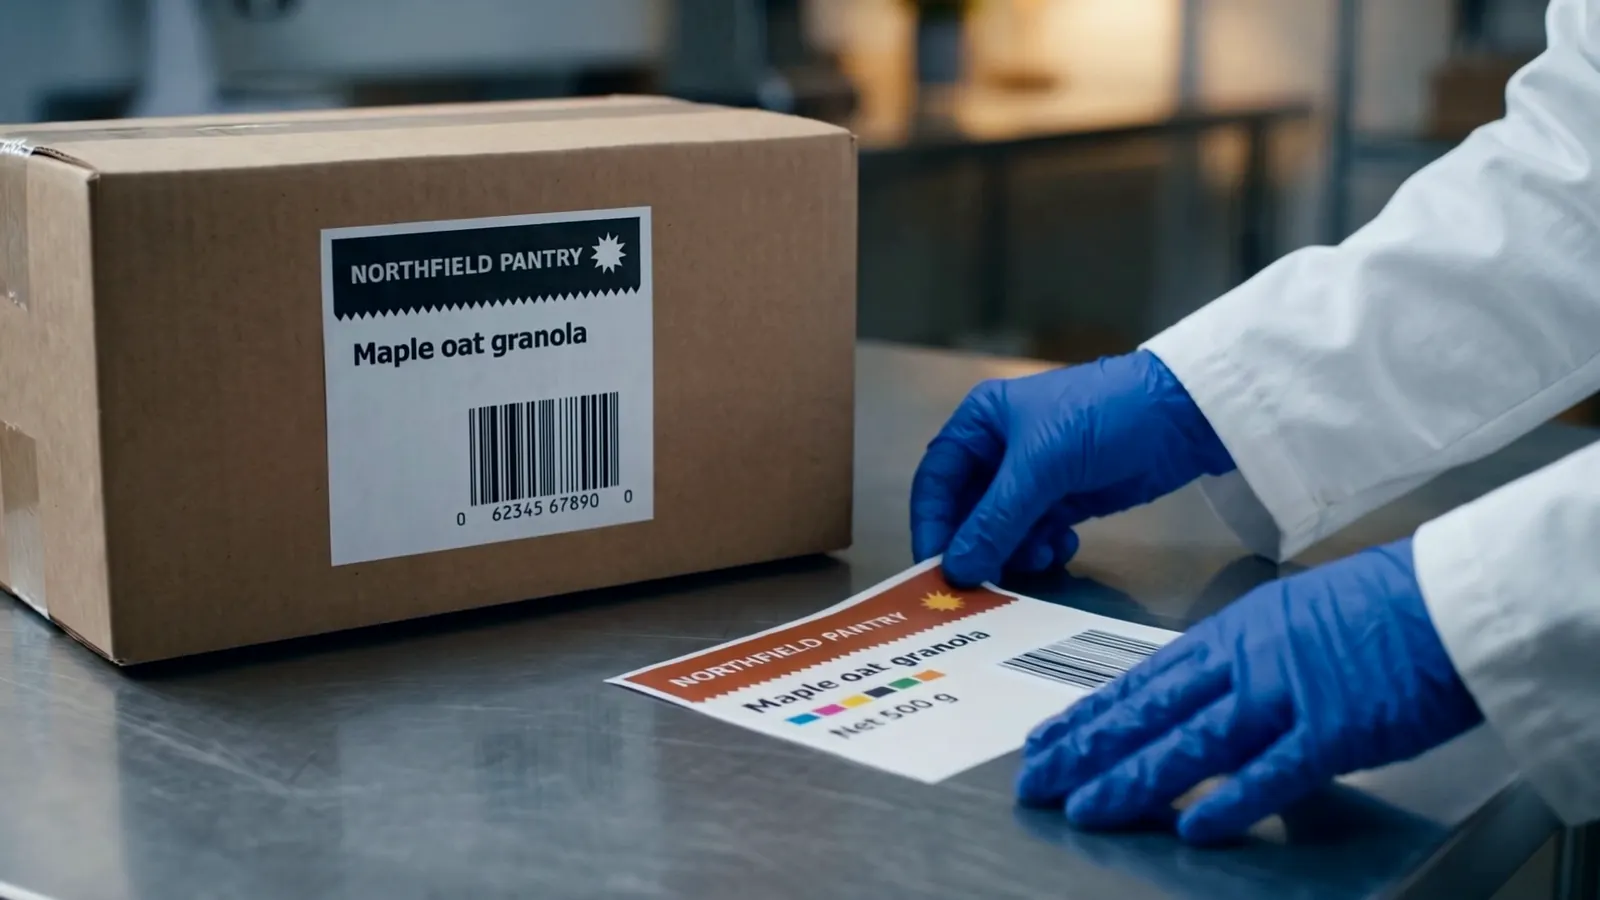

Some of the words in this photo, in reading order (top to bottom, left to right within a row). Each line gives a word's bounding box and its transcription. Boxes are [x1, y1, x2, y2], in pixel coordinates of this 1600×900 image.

[351, 254, 493, 285] NORTHFIELD
[500, 247, 583, 272] PANTRY
[353, 337, 434, 368] Maple
[441, 333, 485, 358] oat
[491, 322, 588, 358] granola
[456, 512, 466, 527] 0
[492, 501, 543, 522] 62345
[549, 493, 600, 514] 67890
[623, 489, 633, 504] 0
[669, 638, 823, 688] NORTHFIELD
[822, 611, 908, 642] PANTRY
[742, 679, 838, 714] Maple
[840, 662, 891, 683] oat
[891, 628, 991, 667] granola
[829, 718, 885, 740] Net
[879, 698, 934, 721] 500
[933, 692, 960, 704] g
